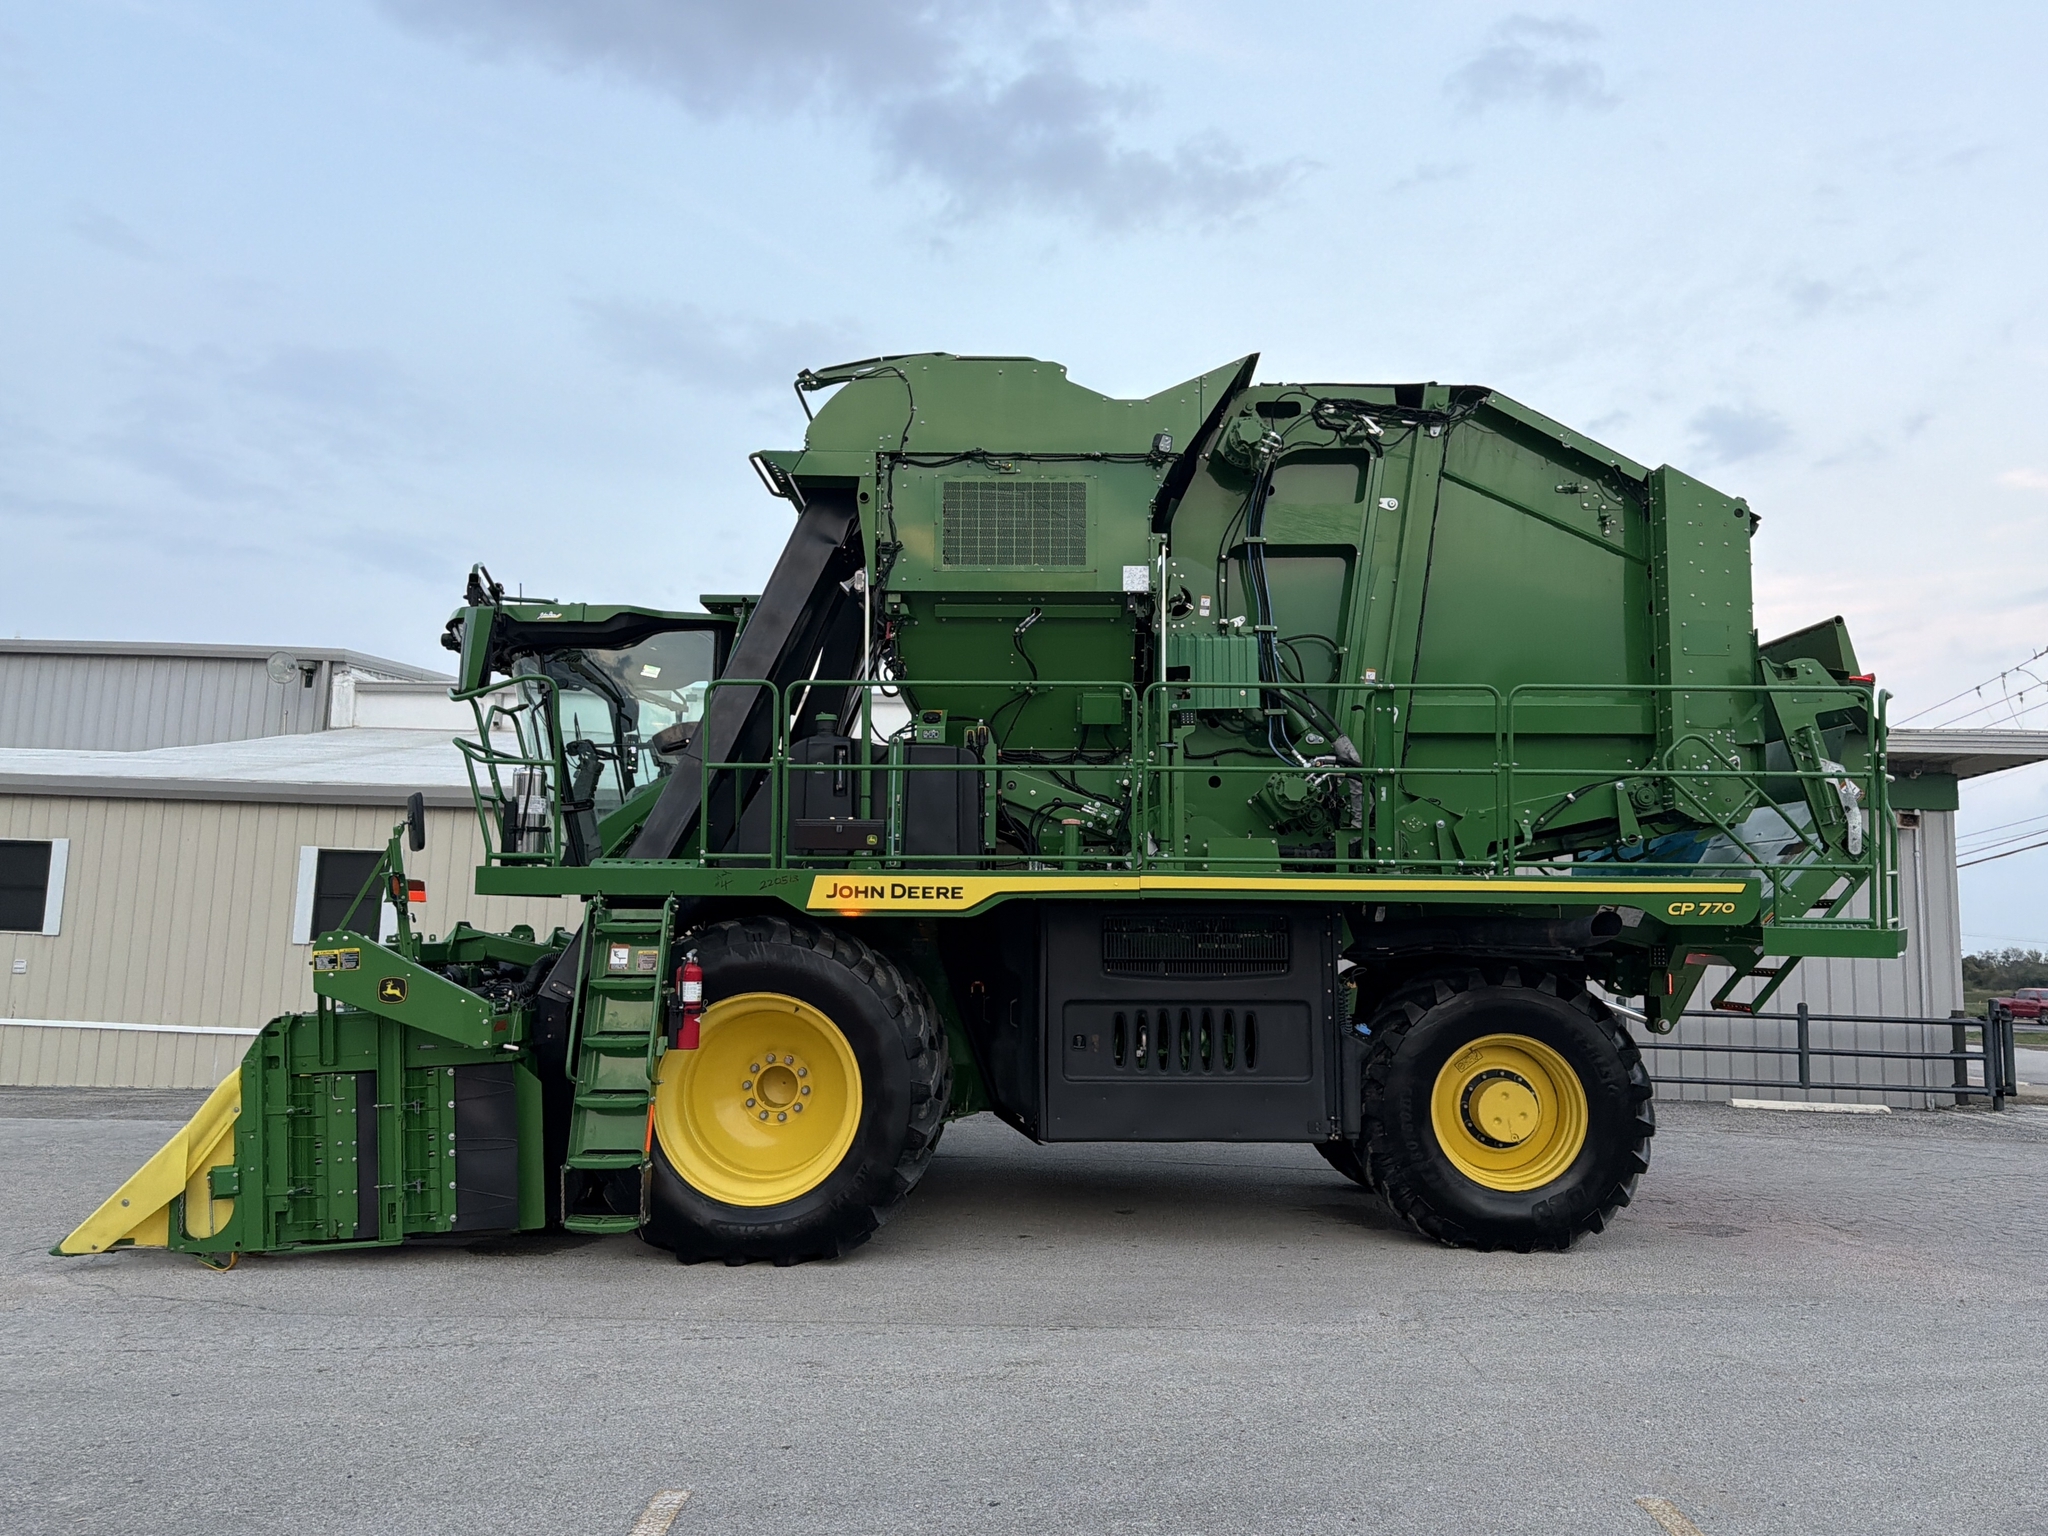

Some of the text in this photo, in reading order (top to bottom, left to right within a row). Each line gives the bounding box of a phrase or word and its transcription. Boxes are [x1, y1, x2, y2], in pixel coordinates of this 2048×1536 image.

[826, 883, 964, 900] JOHN DEERE
[1667, 901, 1736, 916] CP 770
